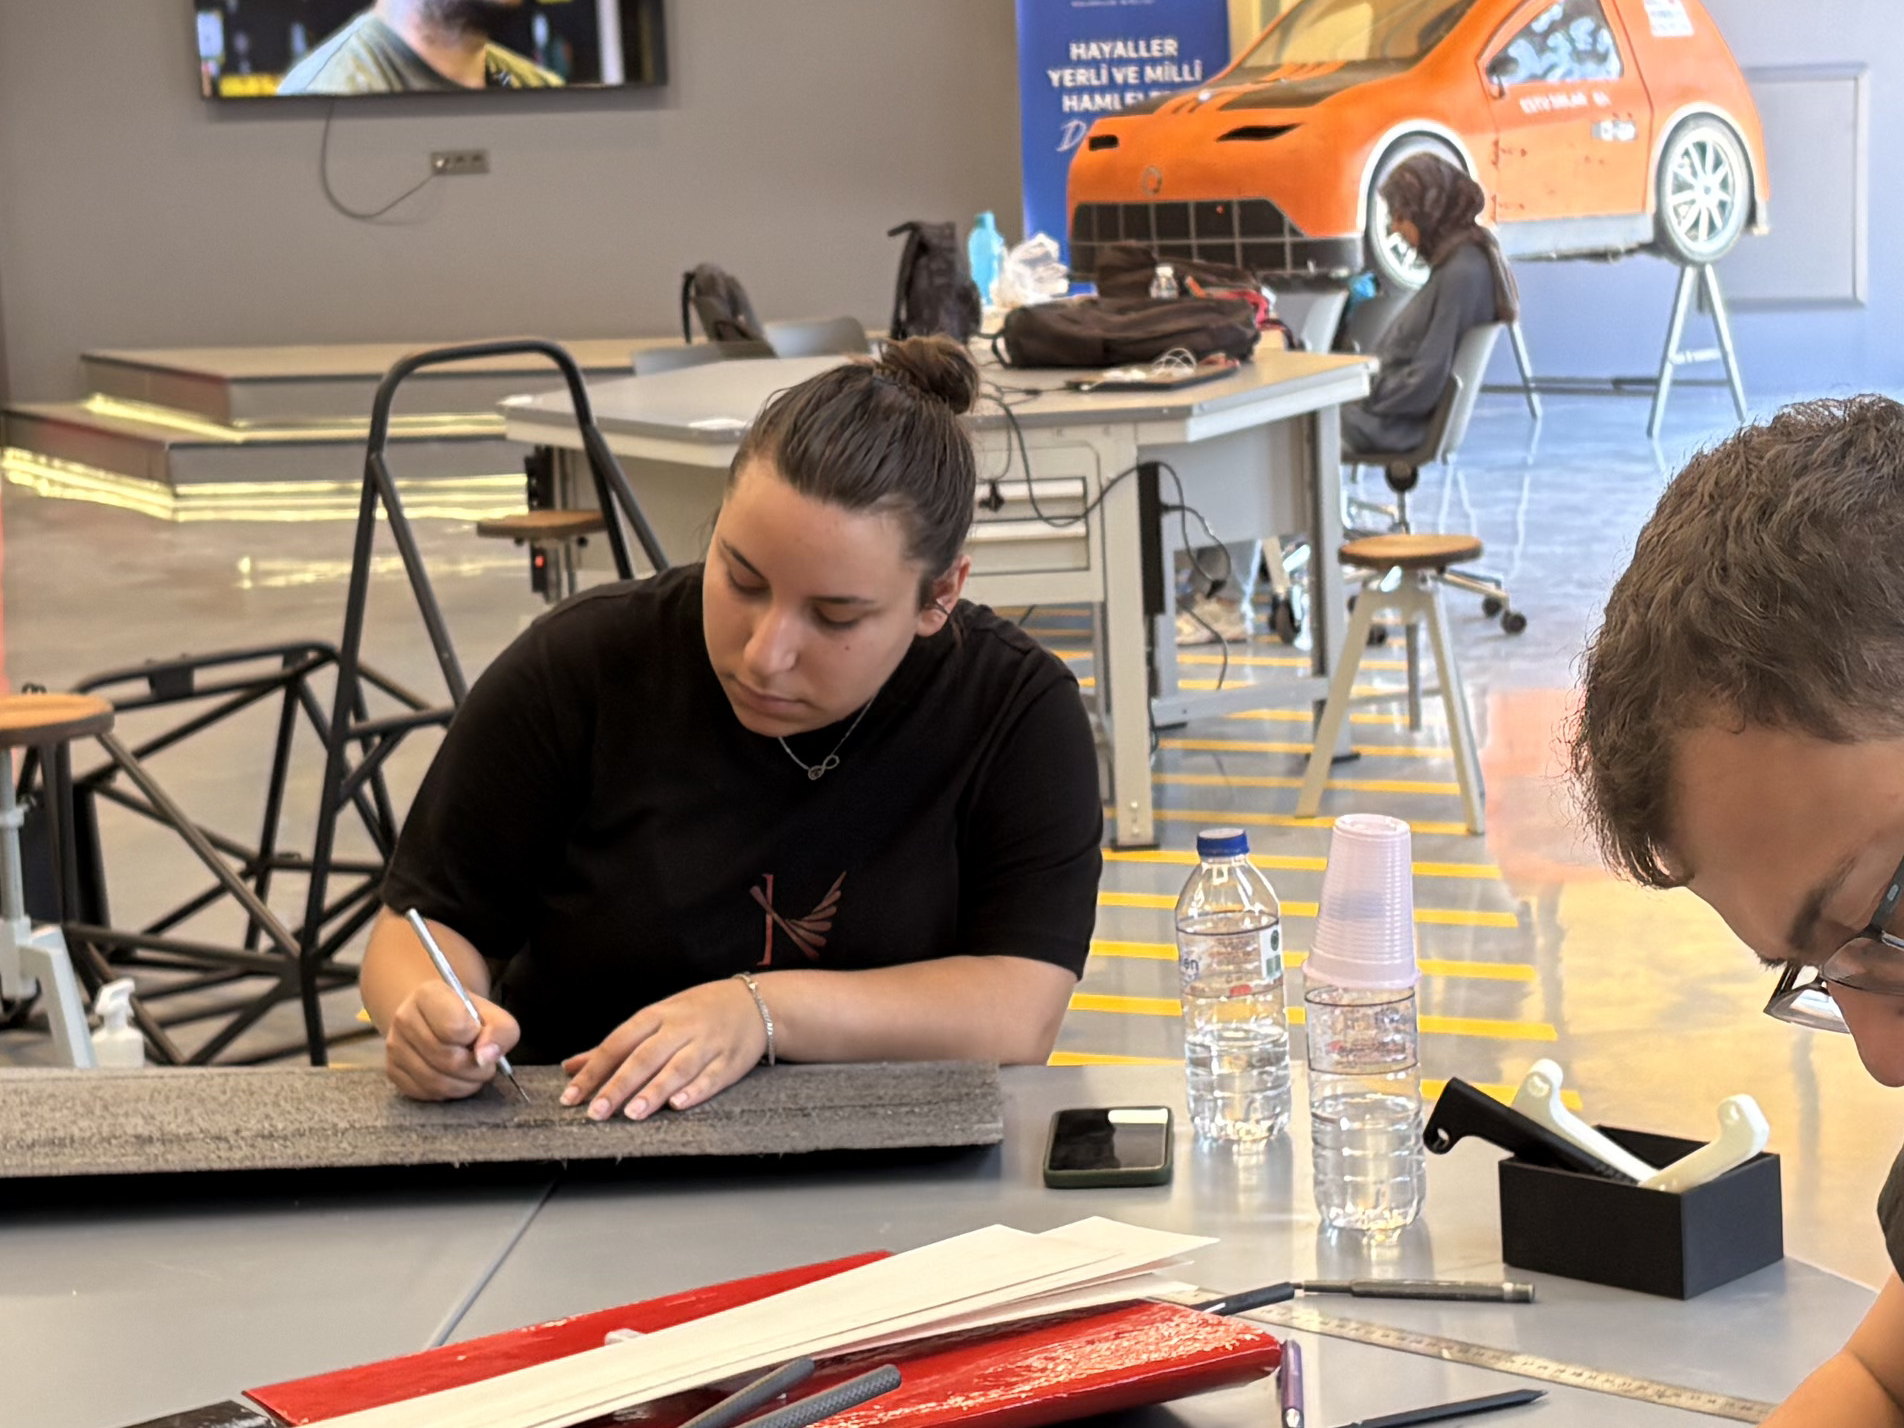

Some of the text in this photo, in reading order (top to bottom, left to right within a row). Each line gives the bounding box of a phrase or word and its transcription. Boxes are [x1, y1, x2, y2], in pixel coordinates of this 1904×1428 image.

[1069, 38, 1178, 61] HAYALLER
[1047, 59, 1203, 87] YERLİ VE MİLLİ
